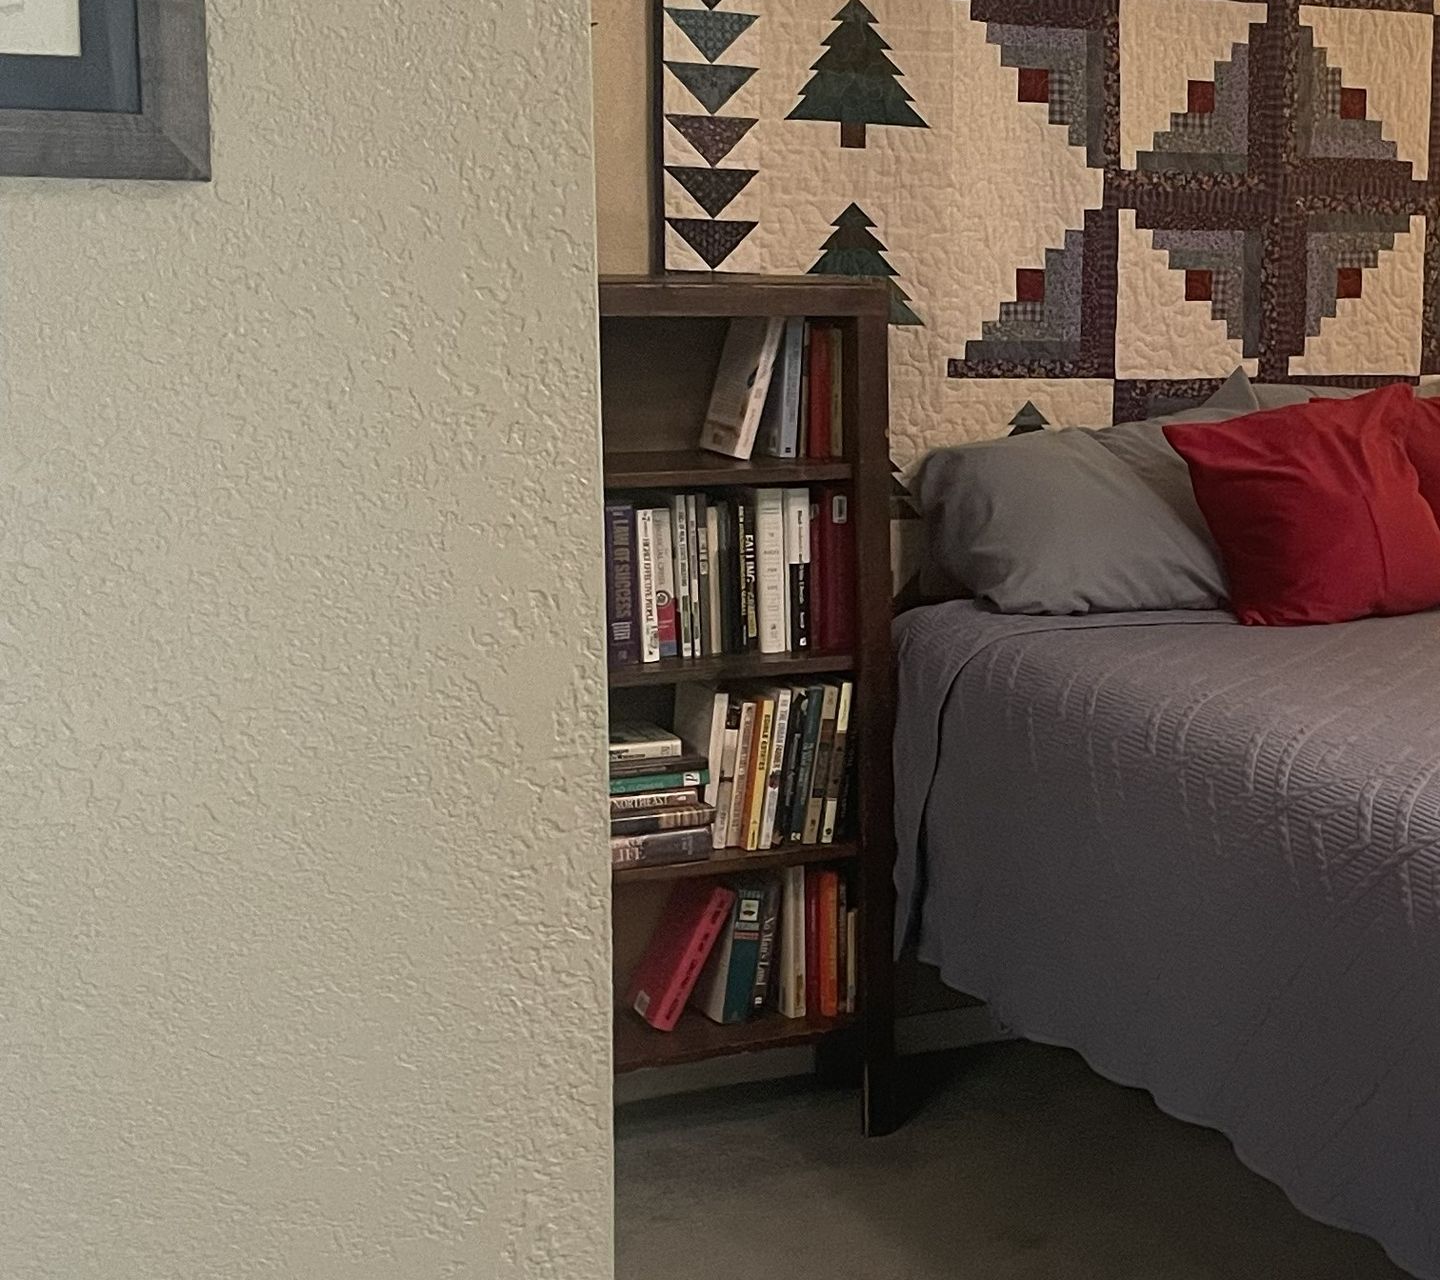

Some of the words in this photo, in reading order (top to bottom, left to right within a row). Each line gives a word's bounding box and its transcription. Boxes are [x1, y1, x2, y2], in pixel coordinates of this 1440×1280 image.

[613, 520, 629, 546] LAW
[613, 547, 630, 562] OF
[744, 534, 756, 583] FALLING
[615, 564, 631, 618] SUCCESS
[611, 795, 669, 810] NORTHEAST
